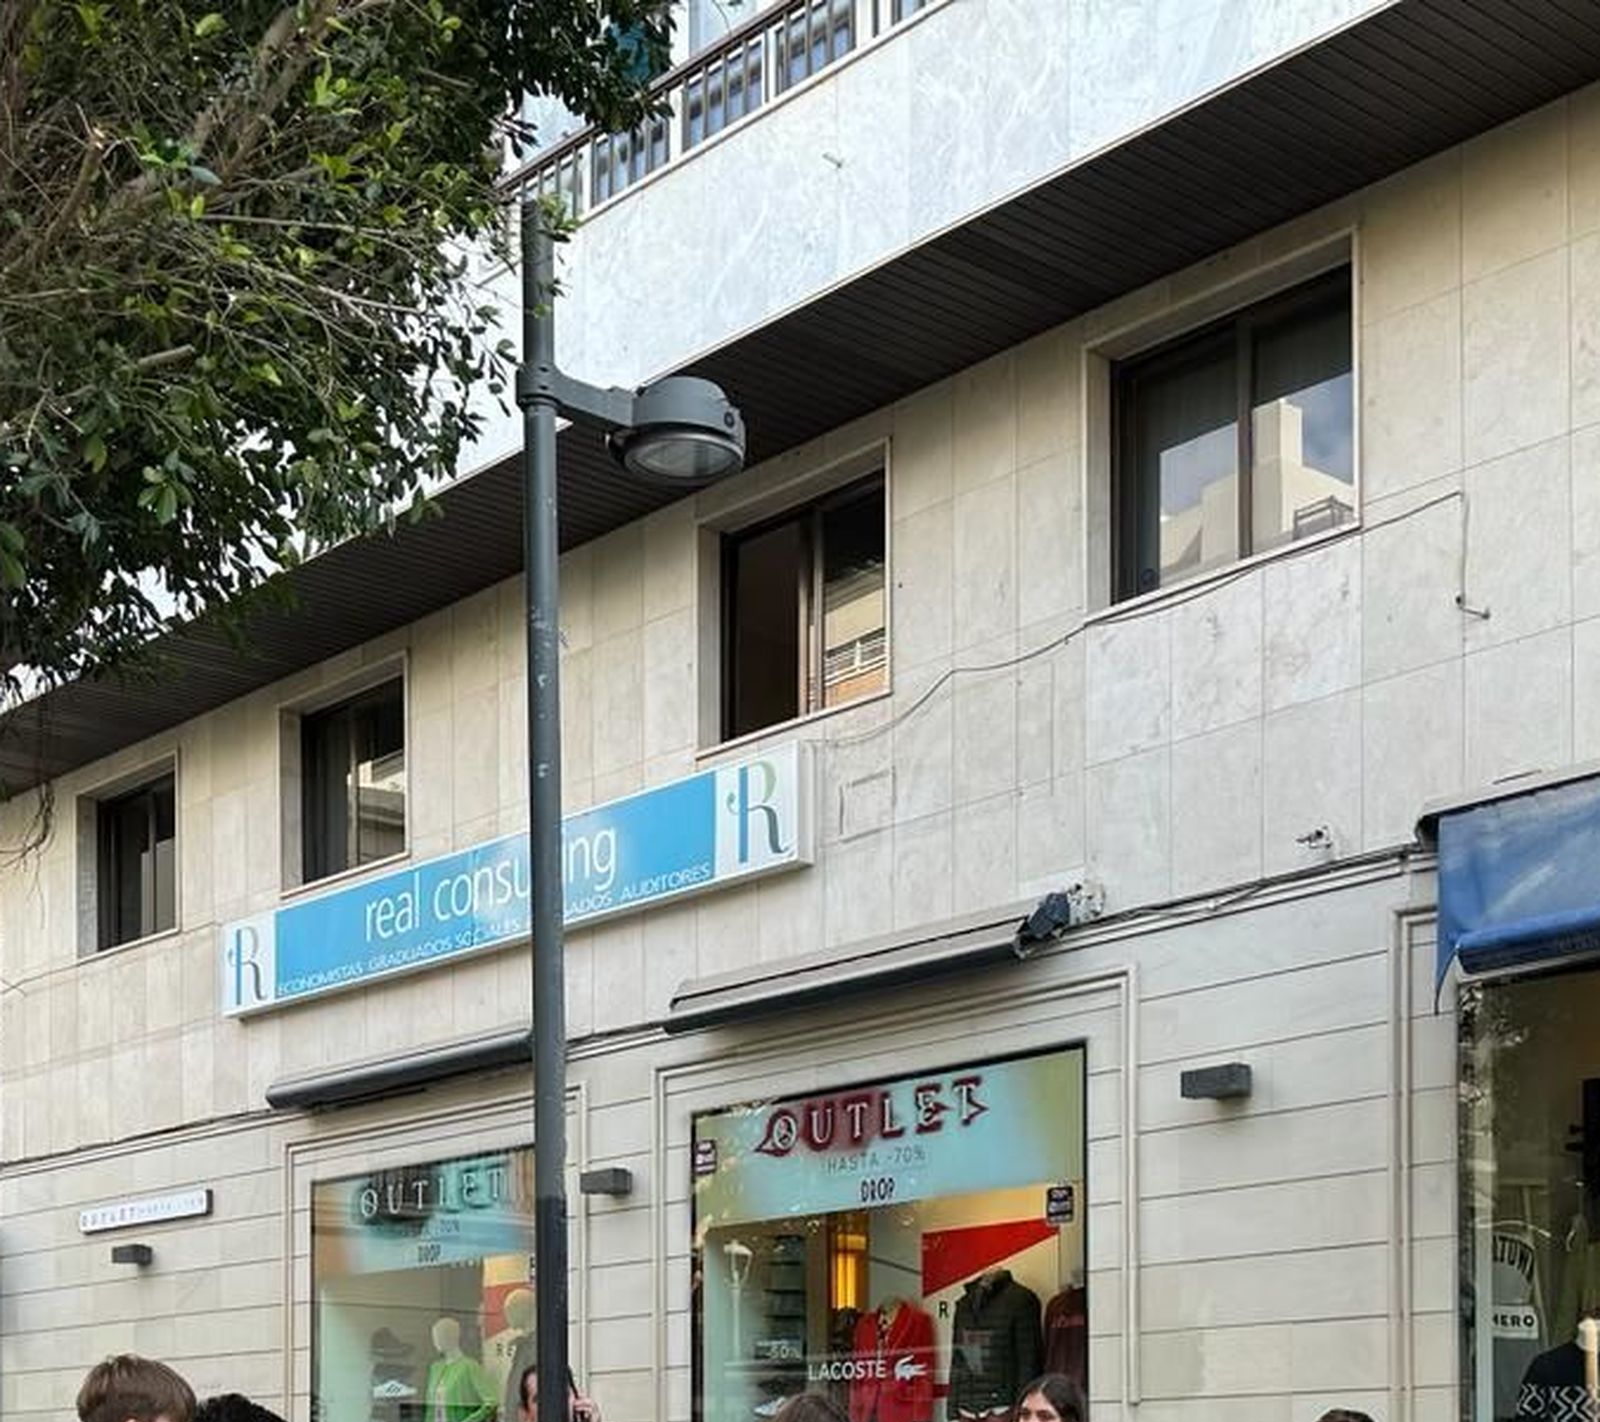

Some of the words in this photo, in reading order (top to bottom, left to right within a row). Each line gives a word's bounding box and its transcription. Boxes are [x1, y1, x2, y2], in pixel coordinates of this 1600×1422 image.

[365, 872, 421, 943] real
[433, 823, 617, 921] consuing
[278, 962, 364, 996] ECONOMISTAS
[368, 936, 451, 971] GRADUADOS
[620, 862, 712, 901] AUDITORES
[765, 1078, 985, 1155] OUTLET
[826, 1152, 880, 1174] HASTA
[360, 1168, 505, 1217] OUTLET
[860, 1177, 896, 1203] DROP
[808, 1360, 887, 1382] LACOSTE
